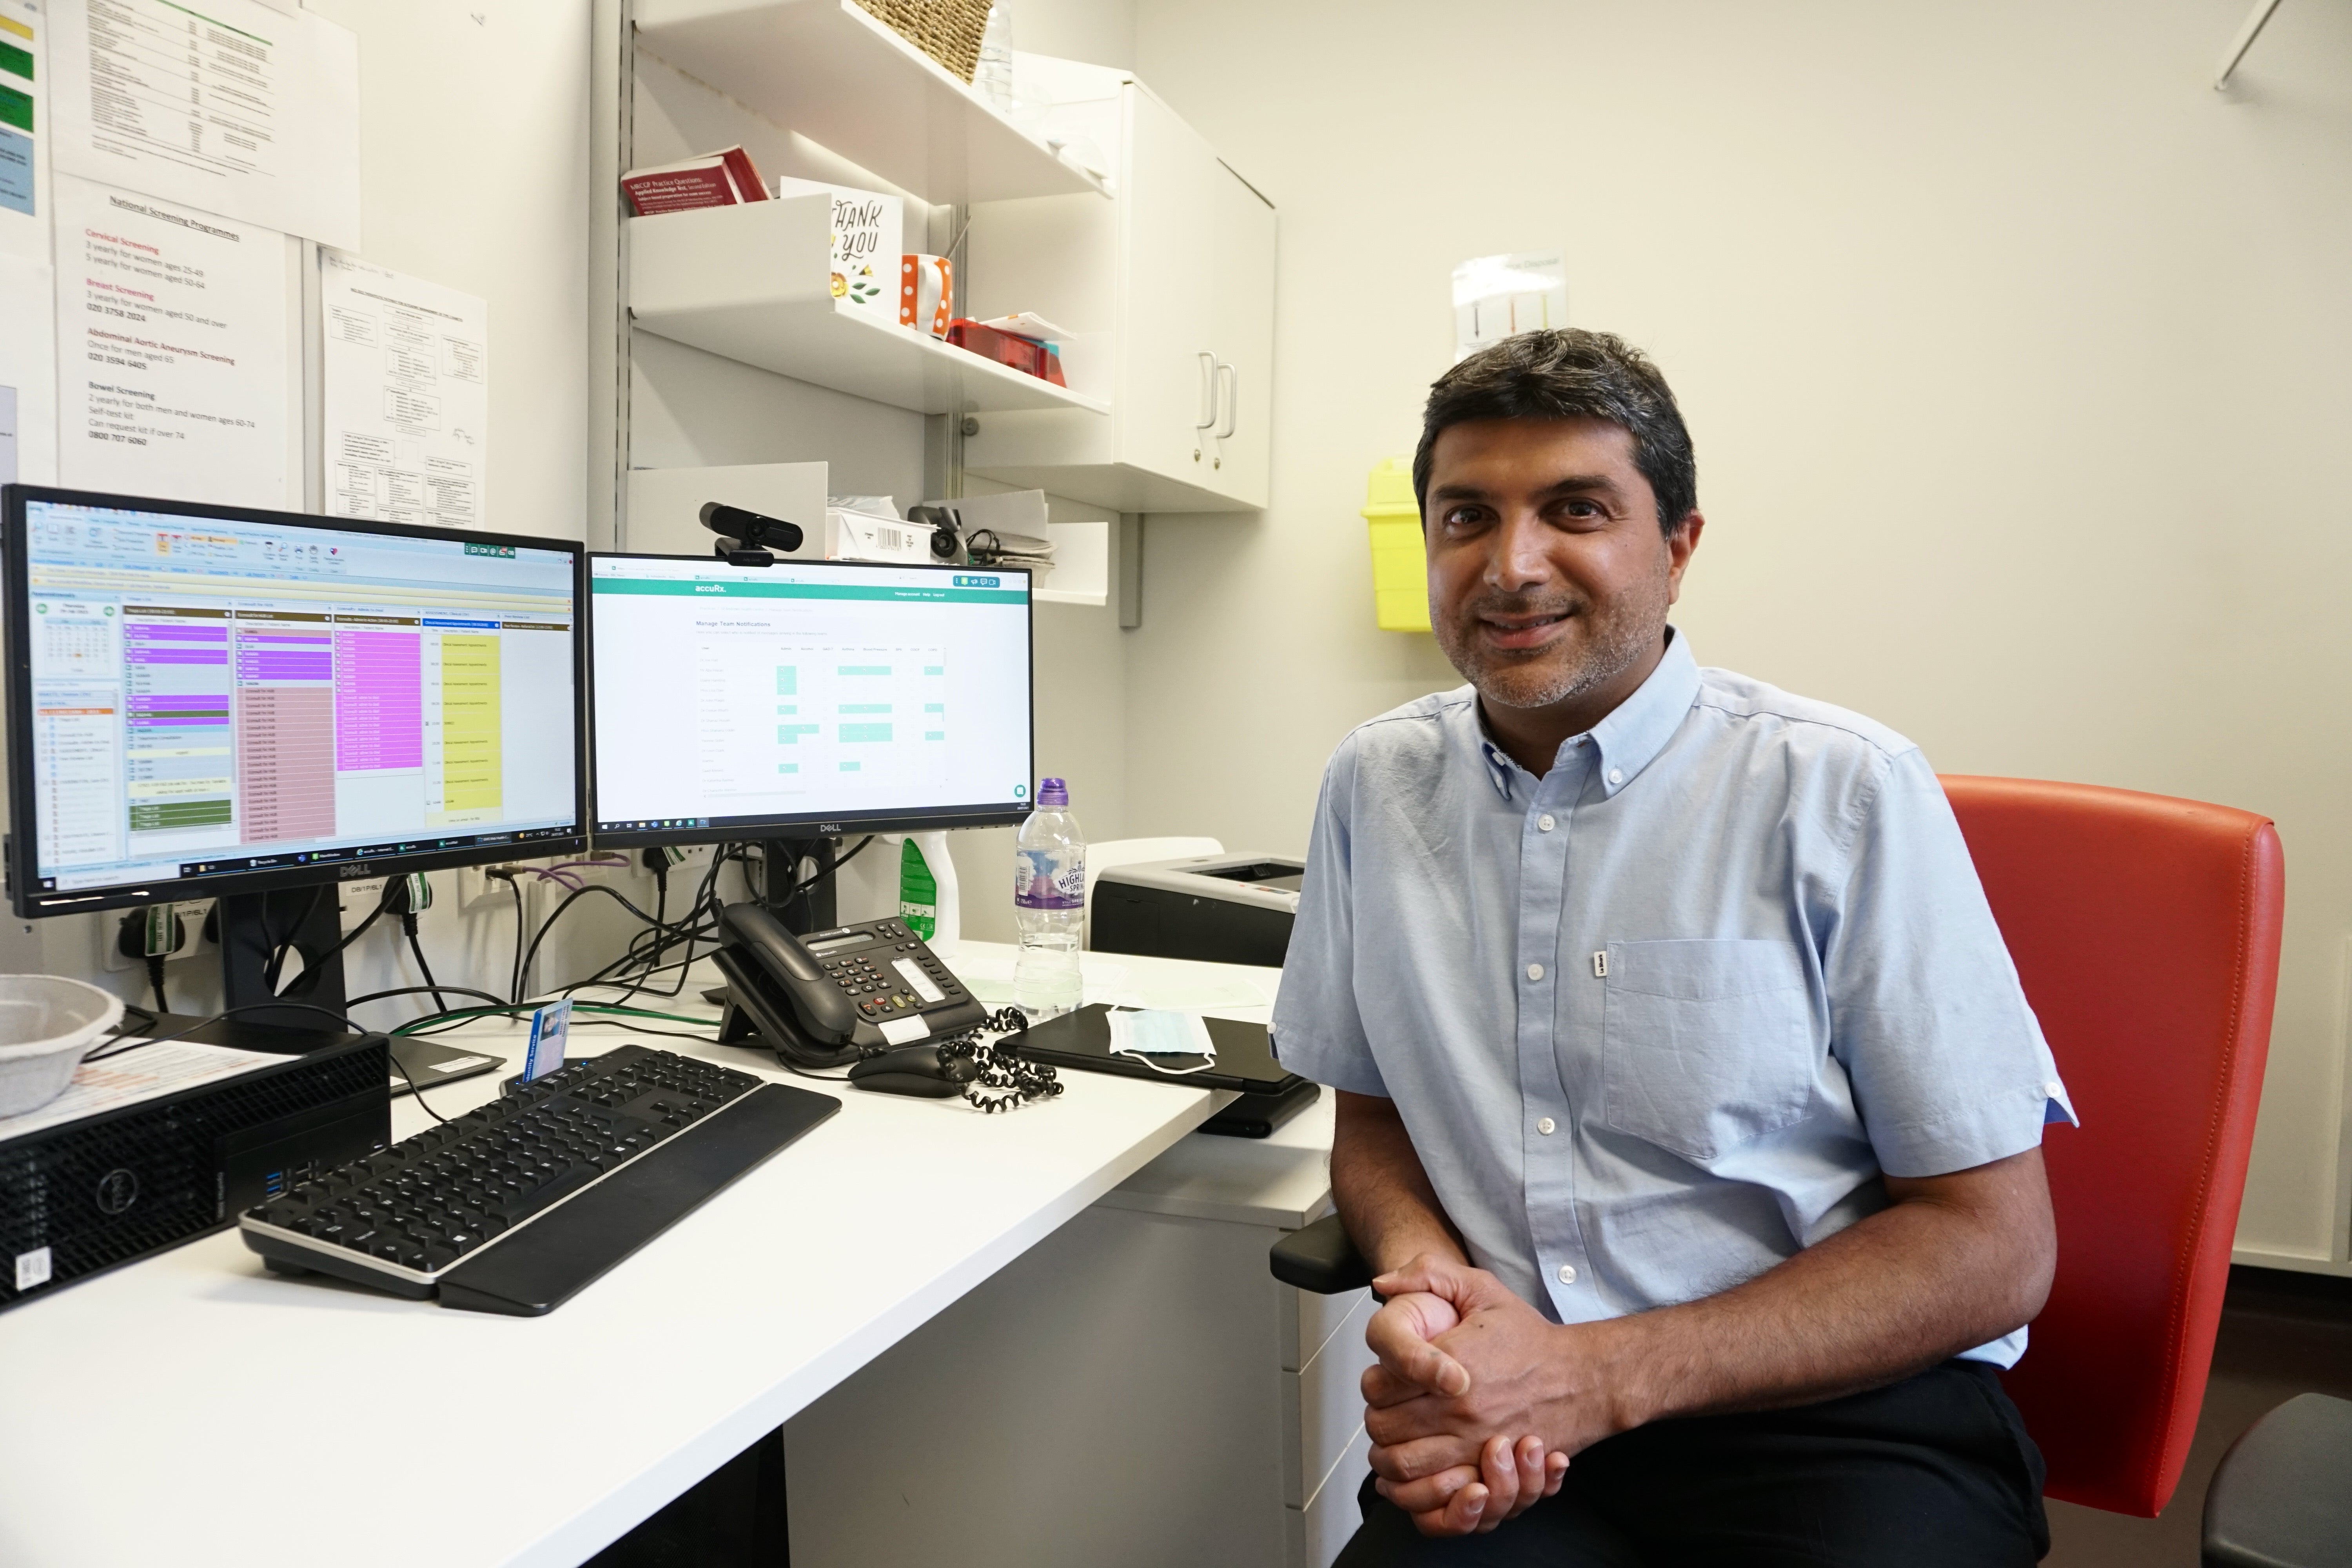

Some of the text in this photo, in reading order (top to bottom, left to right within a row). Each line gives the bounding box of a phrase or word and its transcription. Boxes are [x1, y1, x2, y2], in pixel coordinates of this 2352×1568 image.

[110, 196, 240, 240] National Screening Programmes
[85, 229, 159, 256] Cervical Screening
[842, 232, 878, 261] YOU
[94, 243, 118, 257] yearly
[120, 249, 131, 258] for
[134, 254, 162, 266] women
[165, 261, 181, 272] ages
[94, 256, 118, 269] yearly
[120, 261, 131, 270] for
[134, 266, 162, 278] women
[86, 278, 154, 301] Breast Screening
[87, 303, 102, 312] 020
[127, 312, 146, 322] 2024
[94, 293, 118, 305] yearly
[121, 298, 131, 307] for
[134, 301, 162, 314] women
[165, 308, 182, 319] aged
[196, 316, 209, 325] and
[88, 327, 235, 366] Abdominal Aortic Aneurysm Screening
[88, 340, 108, 350] Once
[111, 345, 122, 353] for
[125, 349, 142, 358] men
[144, 352, 162, 363] aged
[89, 381, 155, 401] Bowel Screening
[89, 407, 134, 420] Self-test kit
[96, 396, 120, 407] yearly
[122, 399, 133, 407] for
[136, 401, 153, 411] both
[156, 406, 172, 415] men
[174, 408, 187, 417] and
[190, 412, 216, 422] women
[218, 416, 233, 426] ages
[235, 419, 255, 428] 60-74
[88, 430, 108, 441] 0800
[111, 434, 125, 443] 707
[89, 419, 103, 427] Can
[106, 421, 136, 433] request
[138, 426, 147, 434] kit
[157, 430, 173, 438] over
[695, 584, 726, 593] accuRx.
[821, 824, 840, 832] DELL
[339, 864, 371, 877] DELL
